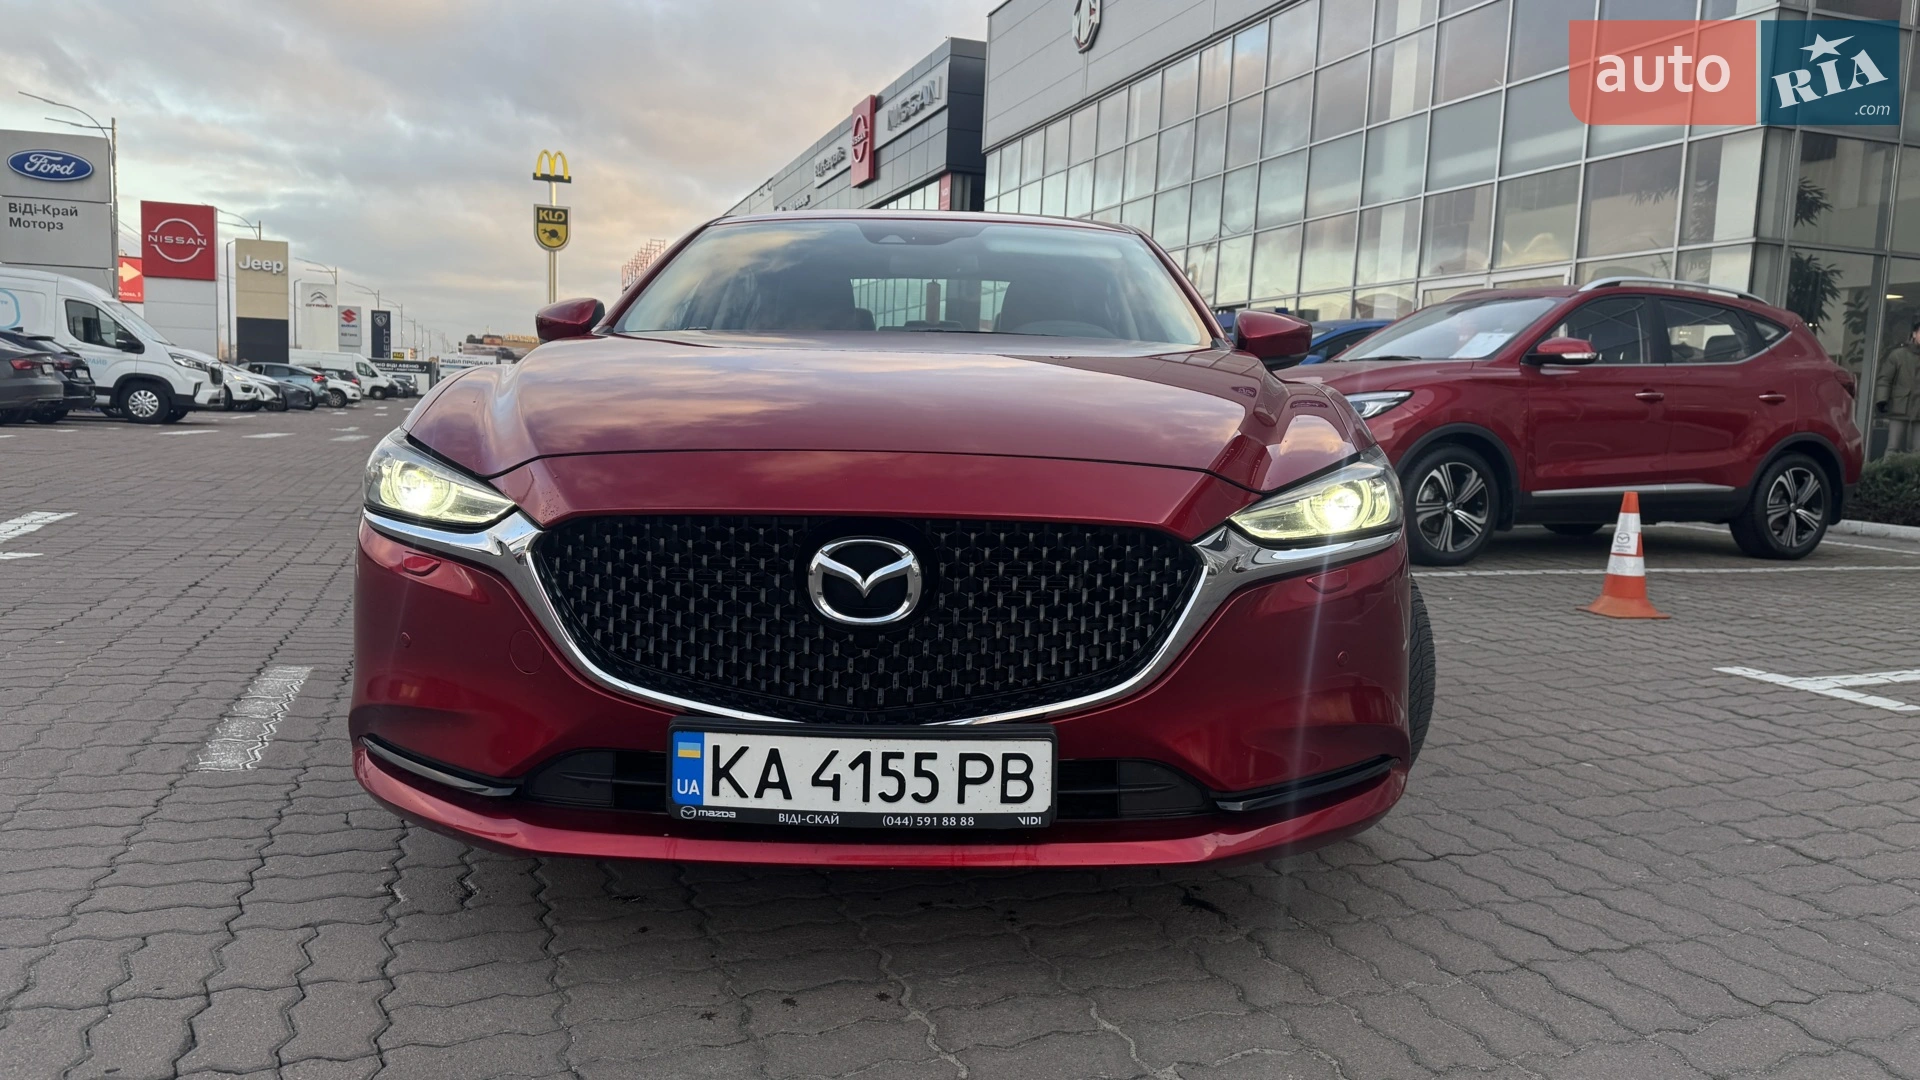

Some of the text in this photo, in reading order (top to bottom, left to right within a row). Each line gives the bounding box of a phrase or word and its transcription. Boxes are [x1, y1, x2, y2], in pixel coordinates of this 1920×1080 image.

[24, 153, 77, 177] Ford
[8, 202, 78, 218] ВіДі-Край
[539, 210, 566, 223] KLO
[9, 217, 64, 231] Моторз
[148, 234, 207, 247] NISSAN
[238, 254, 285, 274] Jeep
[711, 744, 1034, 804] KA 4155 PB
[677, 778, 700, 796] UA
[778, 812, 840, 825] ВІДІ-СКАЙ
[882, 815, 975, 827] (044) 591 88 88
